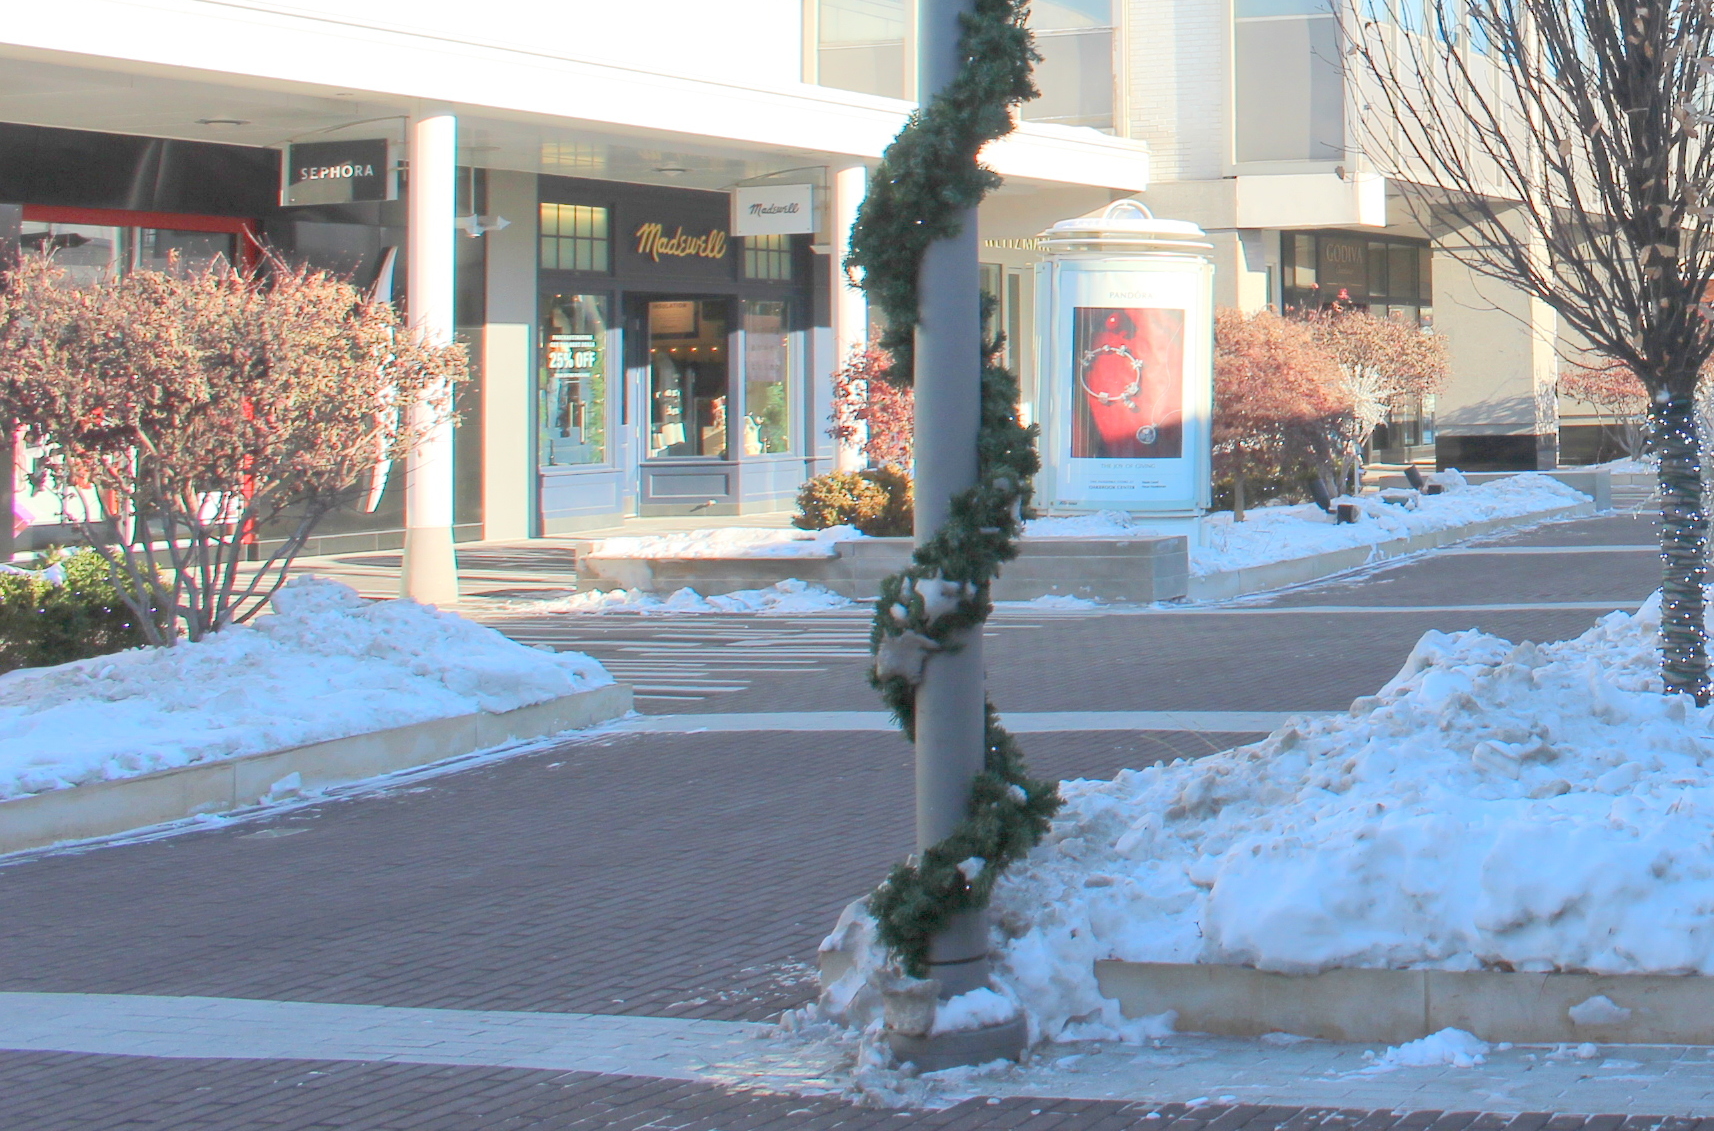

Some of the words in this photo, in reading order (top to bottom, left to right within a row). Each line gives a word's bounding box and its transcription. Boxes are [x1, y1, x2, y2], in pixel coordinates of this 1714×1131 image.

[301, 165, 374, 180] SEPHORA
[749, 203, 800, 217] Madewell
[636, 223, 727, 262] Madewell
[1326, 244, 1363, 264] GODIVA
[1109, 290, 1153, 299] PANDORA
[549, 351, 574, 368] 25%
[575, 351, 597, 368] OFF
